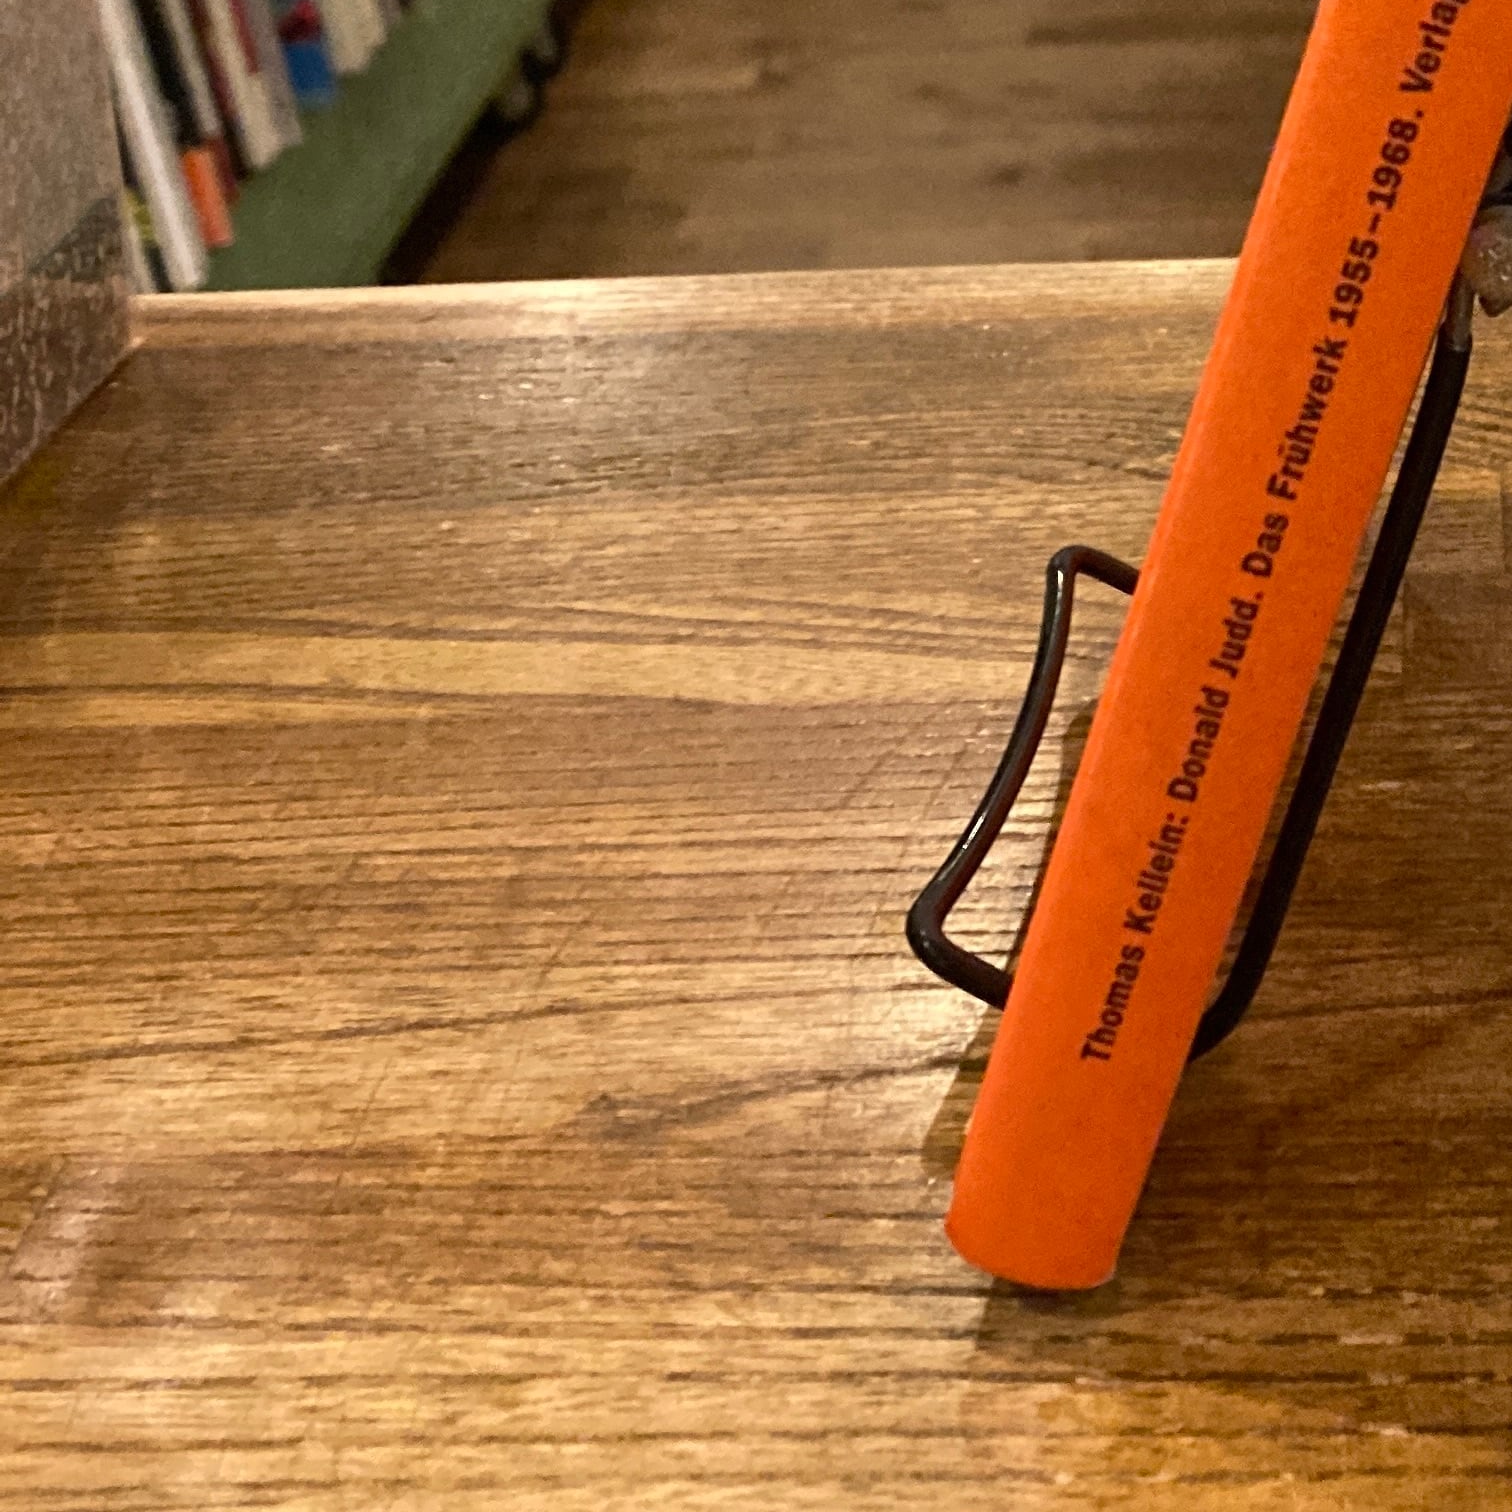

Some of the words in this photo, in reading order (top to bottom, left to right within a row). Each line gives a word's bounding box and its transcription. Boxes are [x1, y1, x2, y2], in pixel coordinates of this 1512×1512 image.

[1080, 945, 1144, 1060] Thomas
[1123, 813, 1188, 934] Kellein:
[1166, 685, 1229, 802] Donald
[1209, 593, 1262, 678] Judd.
[1240, 513, 1288, 578] Das
[1265, 337, 1347, 500] Frühwerk
